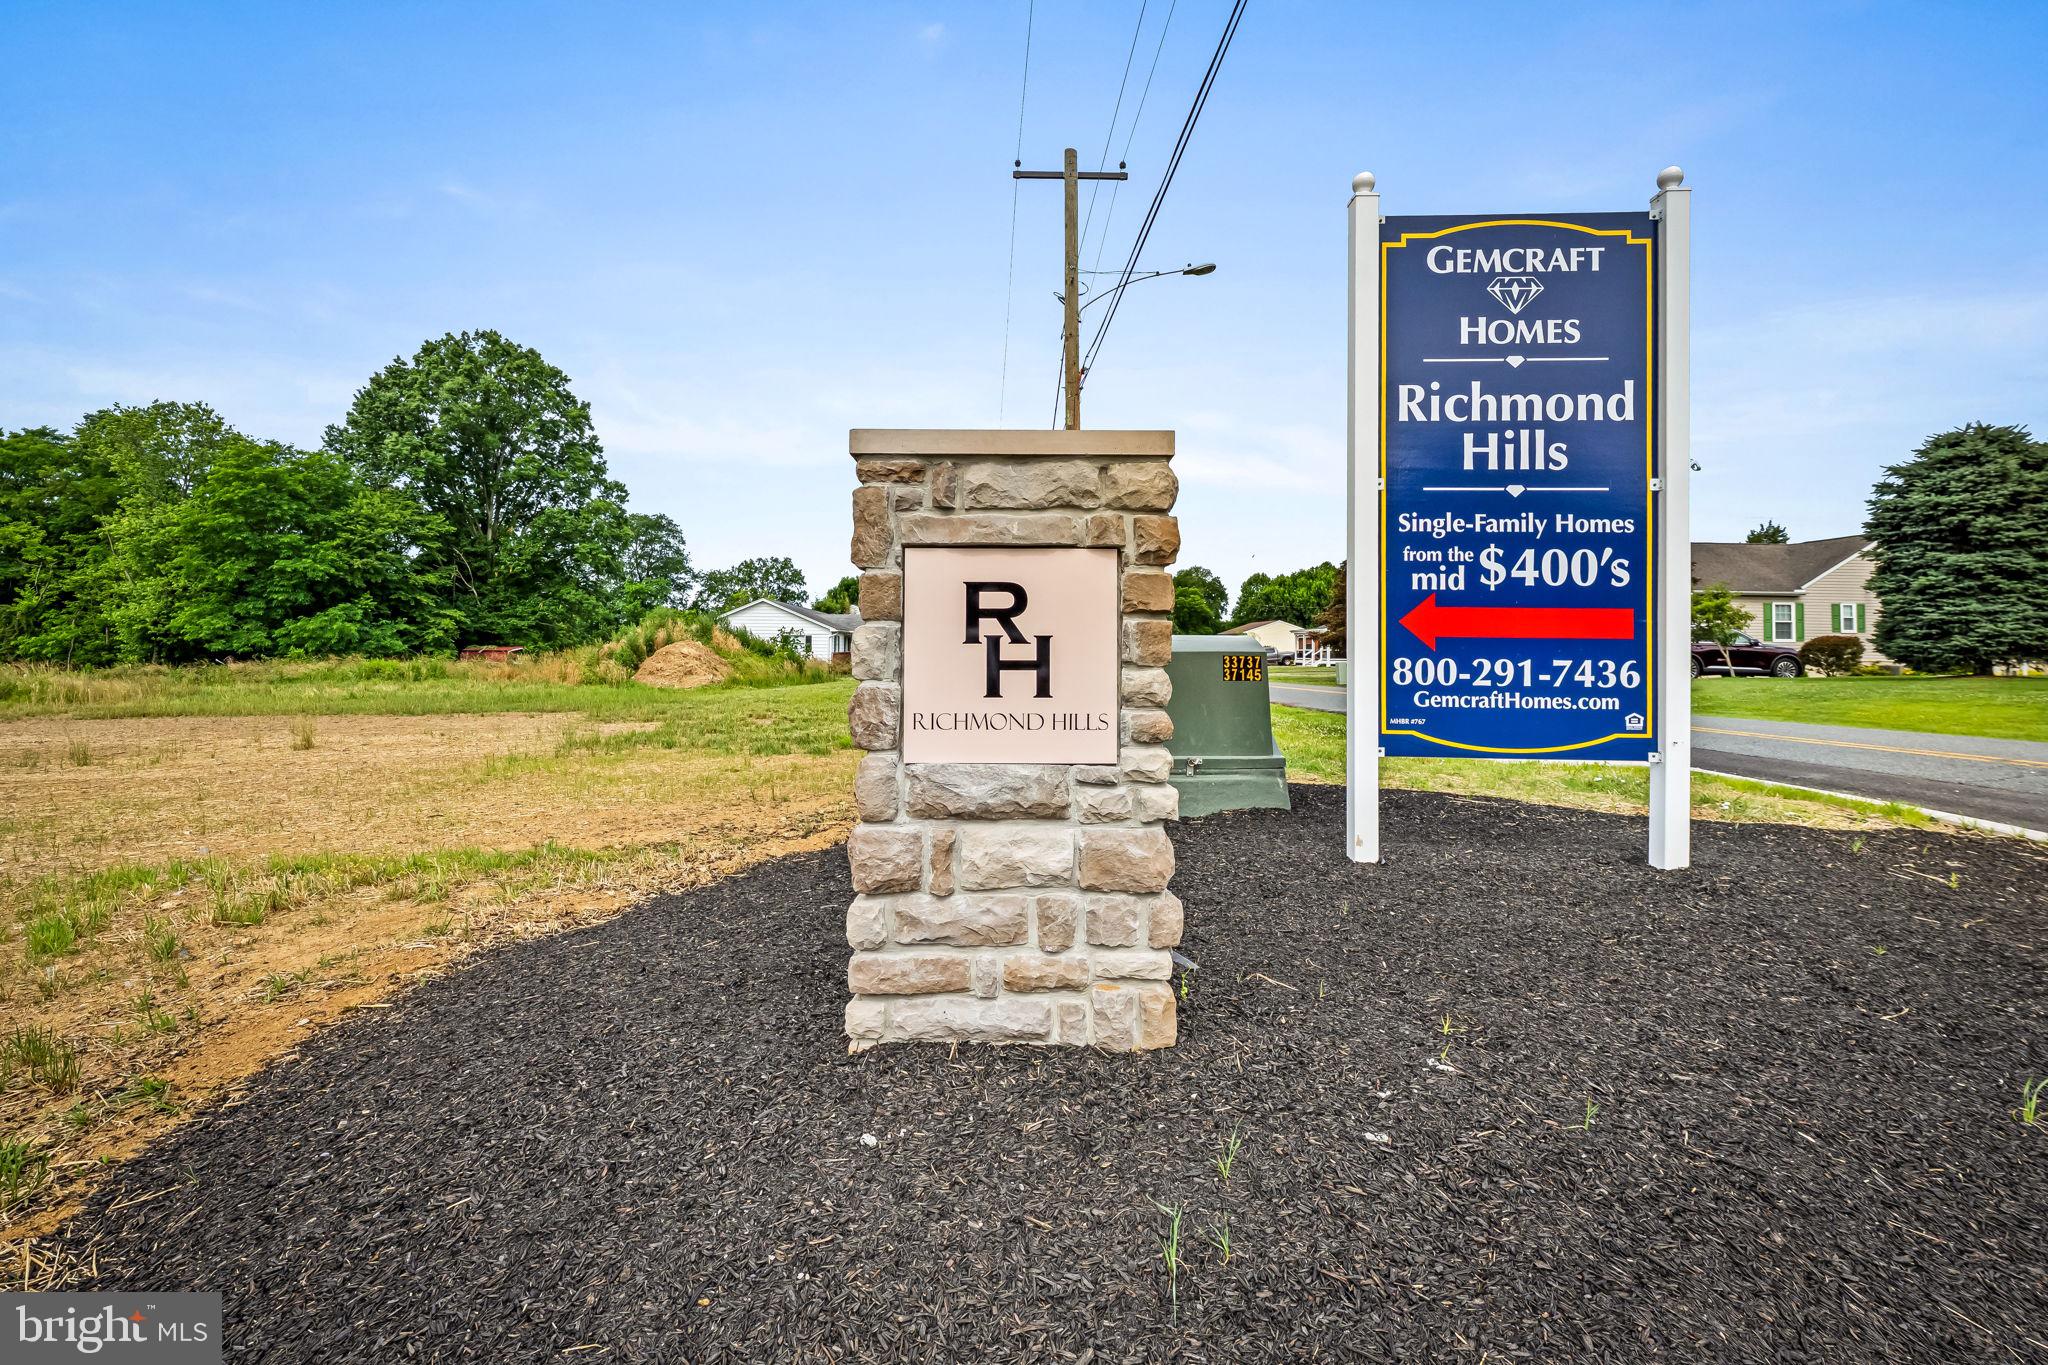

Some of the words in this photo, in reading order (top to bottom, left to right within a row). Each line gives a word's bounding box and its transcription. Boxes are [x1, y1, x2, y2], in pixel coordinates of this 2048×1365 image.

[1426, 245, 1605, 274] GEMCRAFT
[1460, 316, 1581, 345] HOMES
[1398, 380, 1635, 422] Richmond
[1463, 429, 1568, 471] Hills
[1398, 512, 1547, 539] Single-Family
[1555, 514, 1635, 534] Homes
[1403, 546, 1442, 563] from
[1448, 546, 1474, 562] the
[1479, 543, 1630, 591] $400's
[1411, 565, 1465, 591] mid
[1223, 655, 1261, 668] 33737
[1223, 668, 1262, 681] 37145
[1392, 657, 1641, 689] 800-291-7436
[1413, 690, 1620, 711] GemcraftHomes.com
[912, 712, 1045, 731] RICHMOND
[1052, 712, 1109, 731] HILLS
